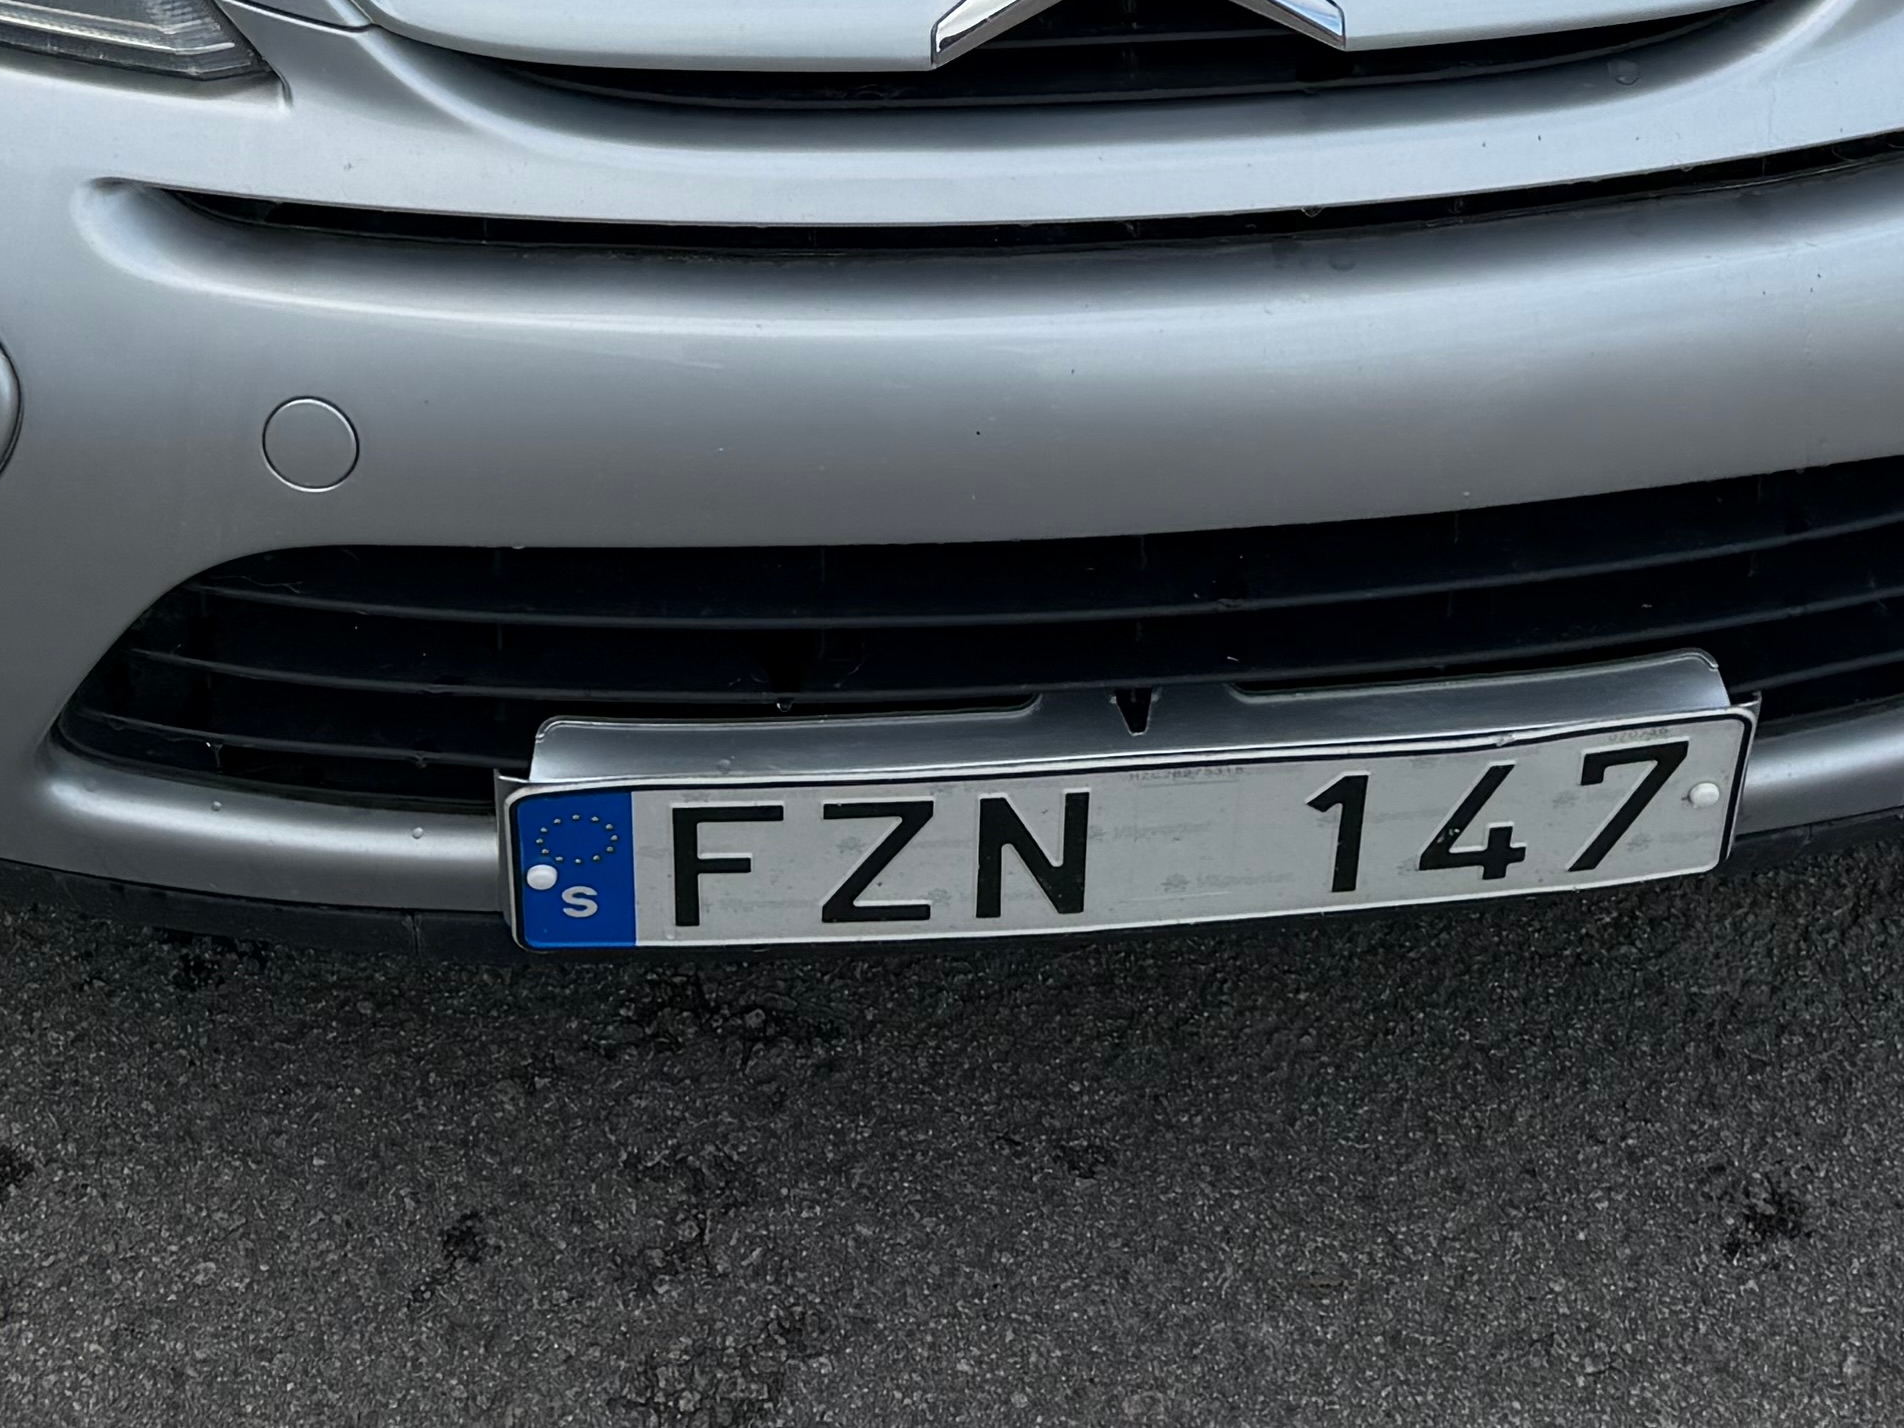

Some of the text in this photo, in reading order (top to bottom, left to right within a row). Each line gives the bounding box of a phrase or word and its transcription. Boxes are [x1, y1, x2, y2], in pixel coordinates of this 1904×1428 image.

[670, 739, 1690, 928] FZN 147
[561, 885, 599, 919] S
